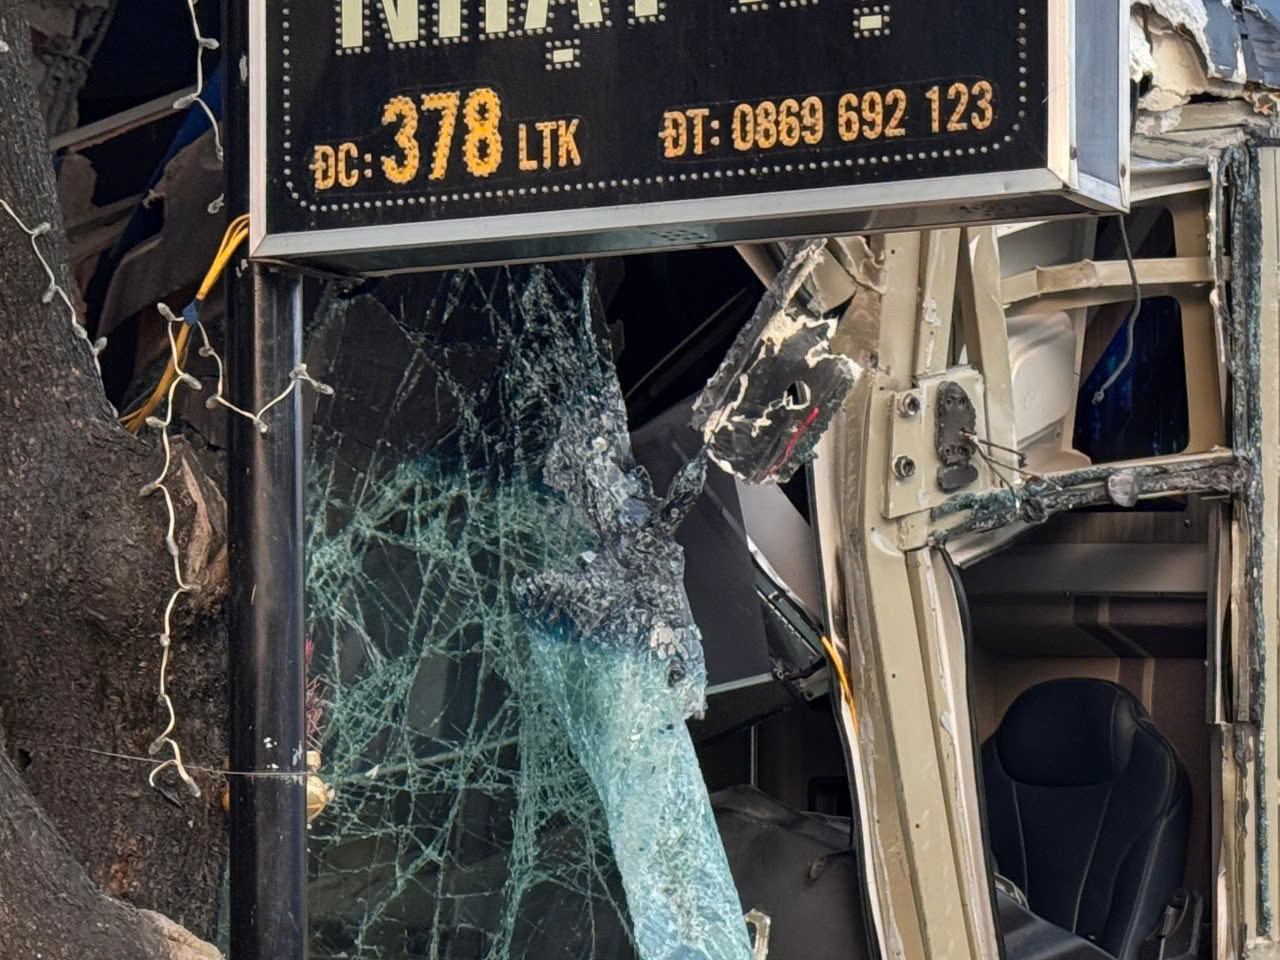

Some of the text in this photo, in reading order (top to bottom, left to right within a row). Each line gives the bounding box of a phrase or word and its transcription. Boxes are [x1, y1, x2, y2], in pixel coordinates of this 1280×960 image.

[309, 87, 581, 191] ĐC: 378 LTK
[659, 80, 995, 159] ĐT: 0869 692 123
